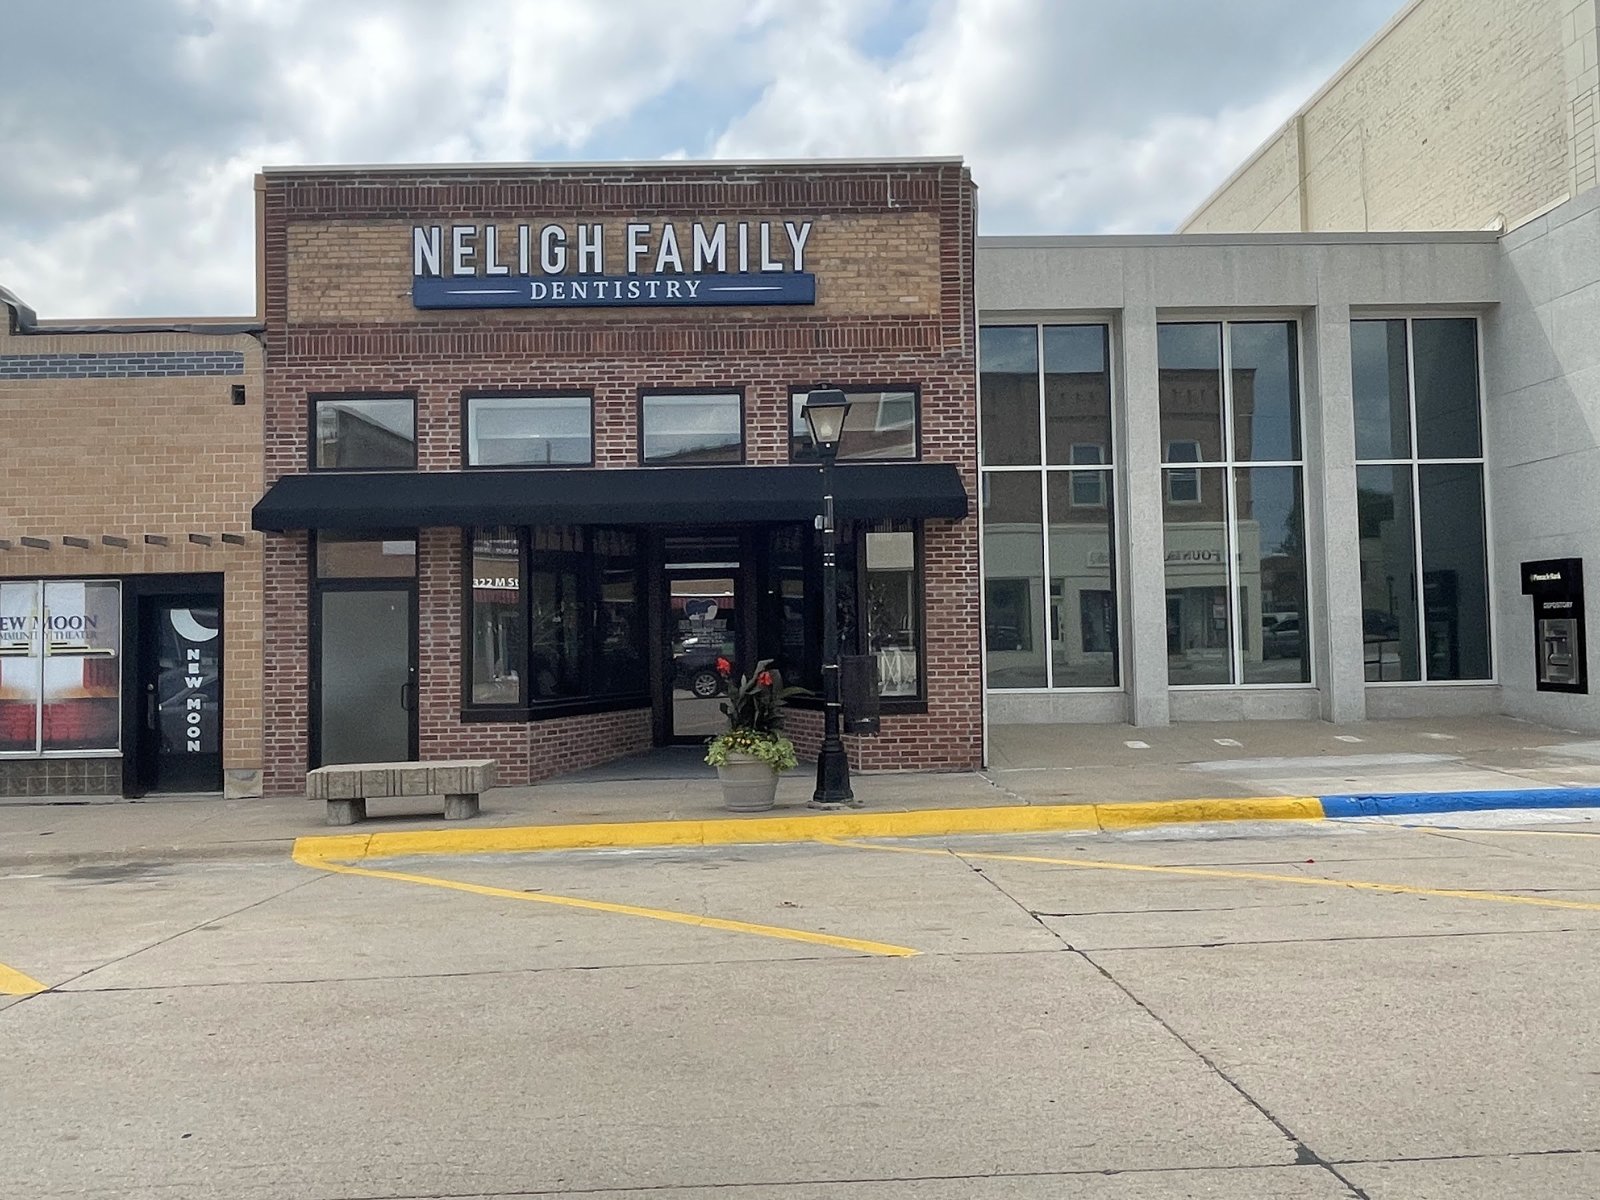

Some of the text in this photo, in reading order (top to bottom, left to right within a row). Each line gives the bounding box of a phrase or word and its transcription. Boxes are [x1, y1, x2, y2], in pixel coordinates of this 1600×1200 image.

[413, 222, 812, 276] NELIGH FAMILY
[530, 279, 700, 300] DENTISTRY
[495, 578, 506, 586] M
[0, 615, 98, 631] EW MOON
[185, 649, 203, 752] NEW MOON
